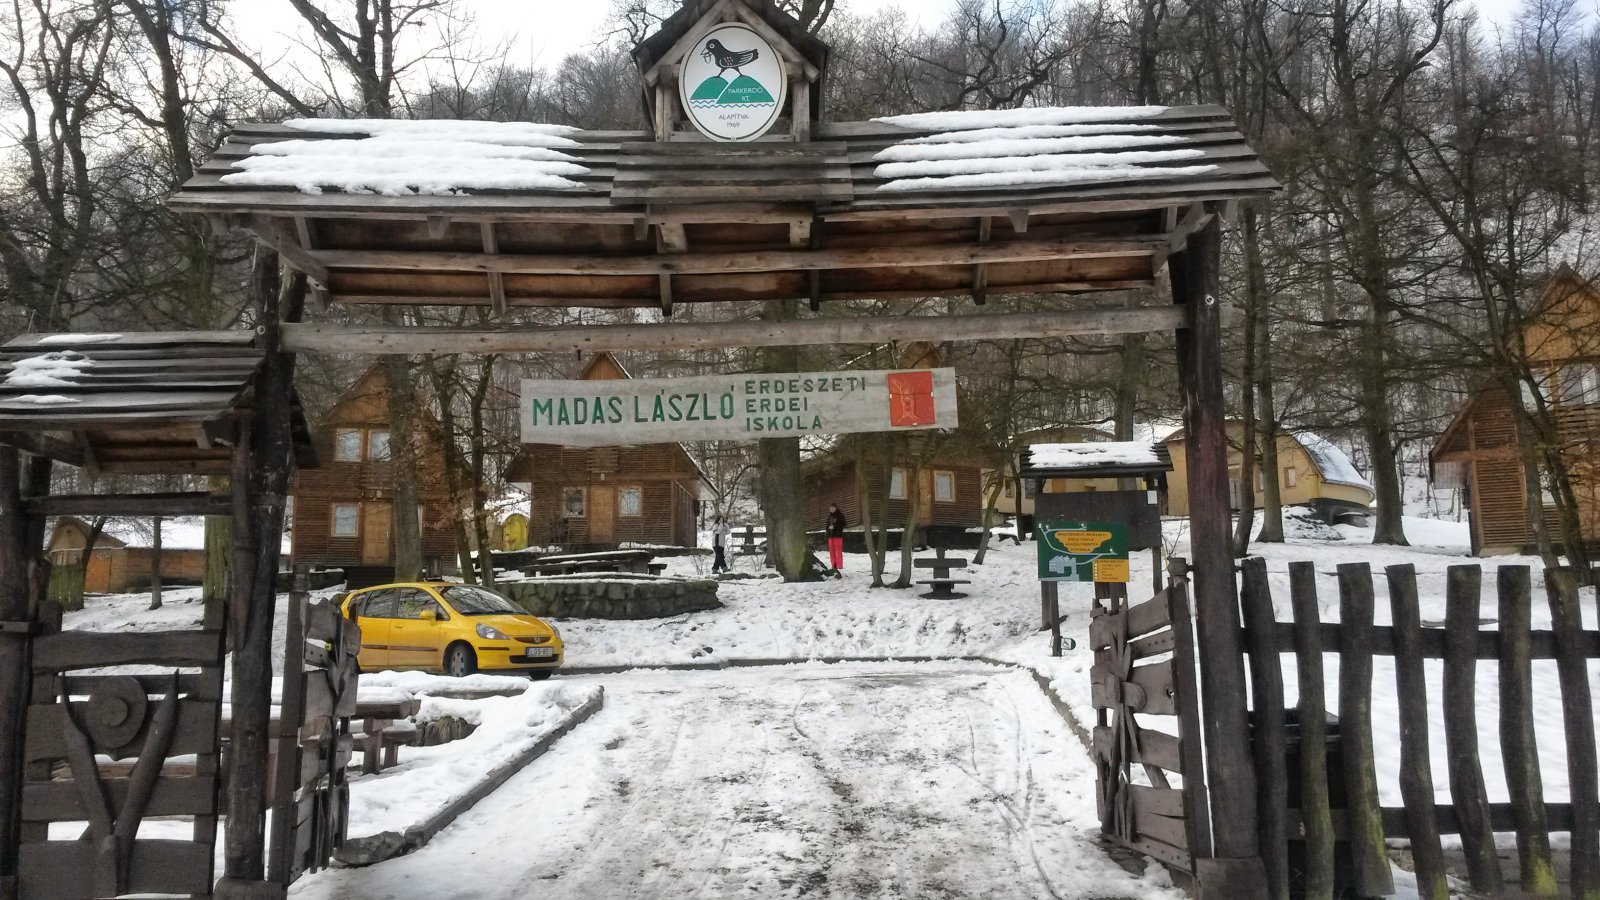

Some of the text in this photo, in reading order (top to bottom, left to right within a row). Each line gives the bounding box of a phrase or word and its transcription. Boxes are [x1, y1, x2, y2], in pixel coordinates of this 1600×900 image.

[745, 375, 866, 395] ERDÉSZETI
[532, 385, 735, 426] MADAS LÁSZLÓ
[745, 397, 808, 413] ERDEI
[746, 415, 823, 432] ISKOLA
